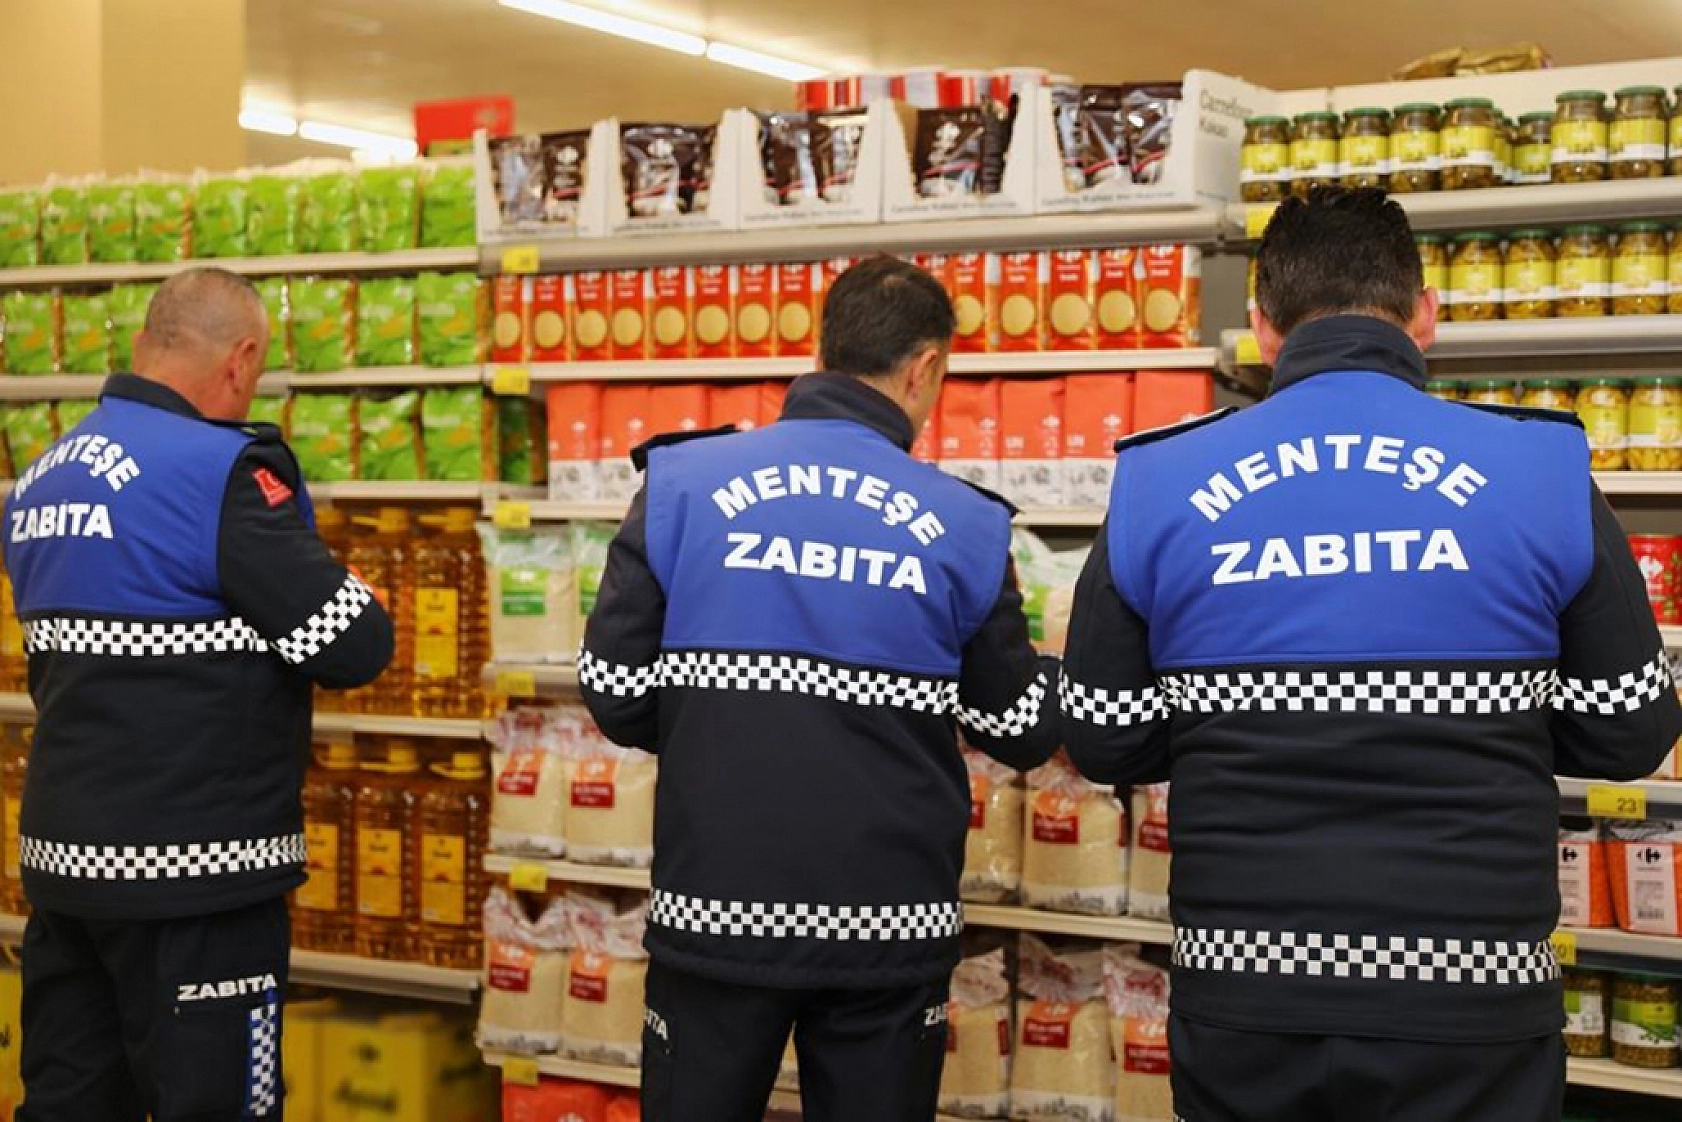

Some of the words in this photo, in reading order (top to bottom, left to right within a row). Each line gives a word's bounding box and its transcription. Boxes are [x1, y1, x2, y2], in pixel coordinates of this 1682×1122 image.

[711, 463, 946, 546] MENTEŞE
[1189, 434, 1488, 522] MENTEŞE
[723, 532, 927, 594] ZABITA
[1211, 529, 1469, 585] ZABITA
[177, 973, 278, 1002] ZABITA
